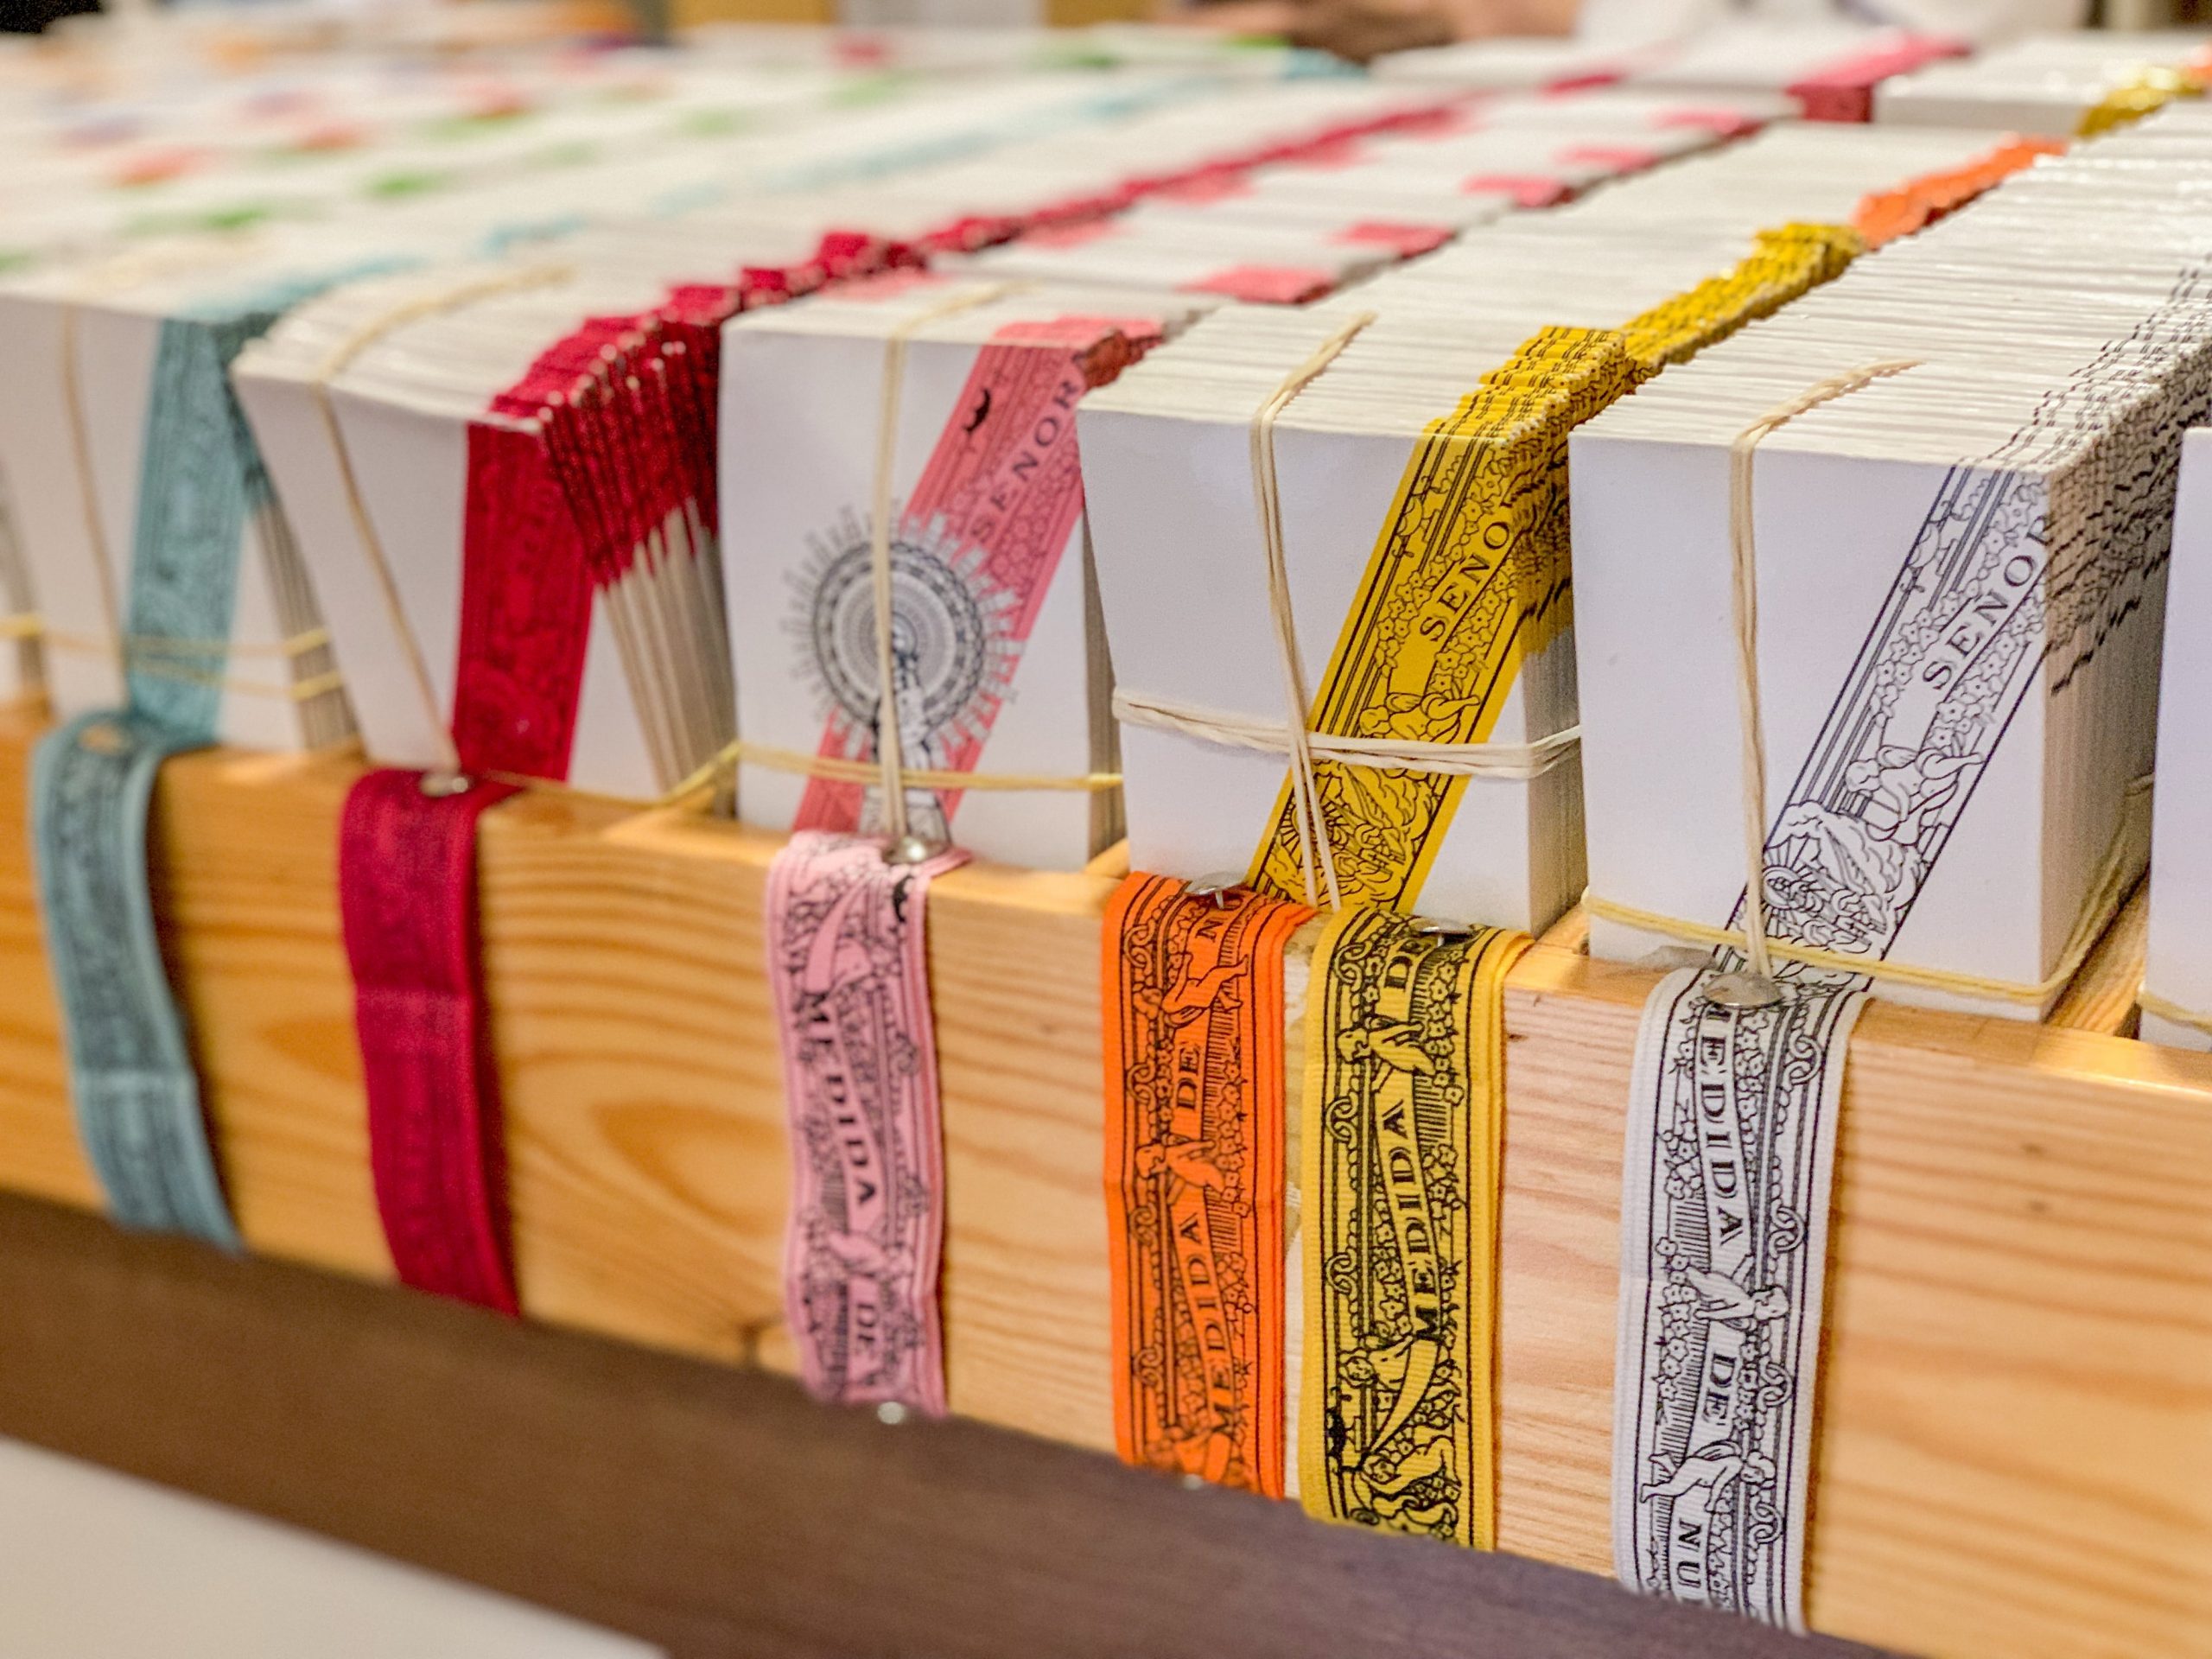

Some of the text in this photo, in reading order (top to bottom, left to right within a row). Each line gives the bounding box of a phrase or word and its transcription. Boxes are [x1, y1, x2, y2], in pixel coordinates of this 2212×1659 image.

[1420, 501, 1512, 642] SENO
[1176, 1042, 1199, 1110] DE
[1382, 1099, 1445, 1342] MEDIDA
[1703, 1351, 1737, 1426] DE
